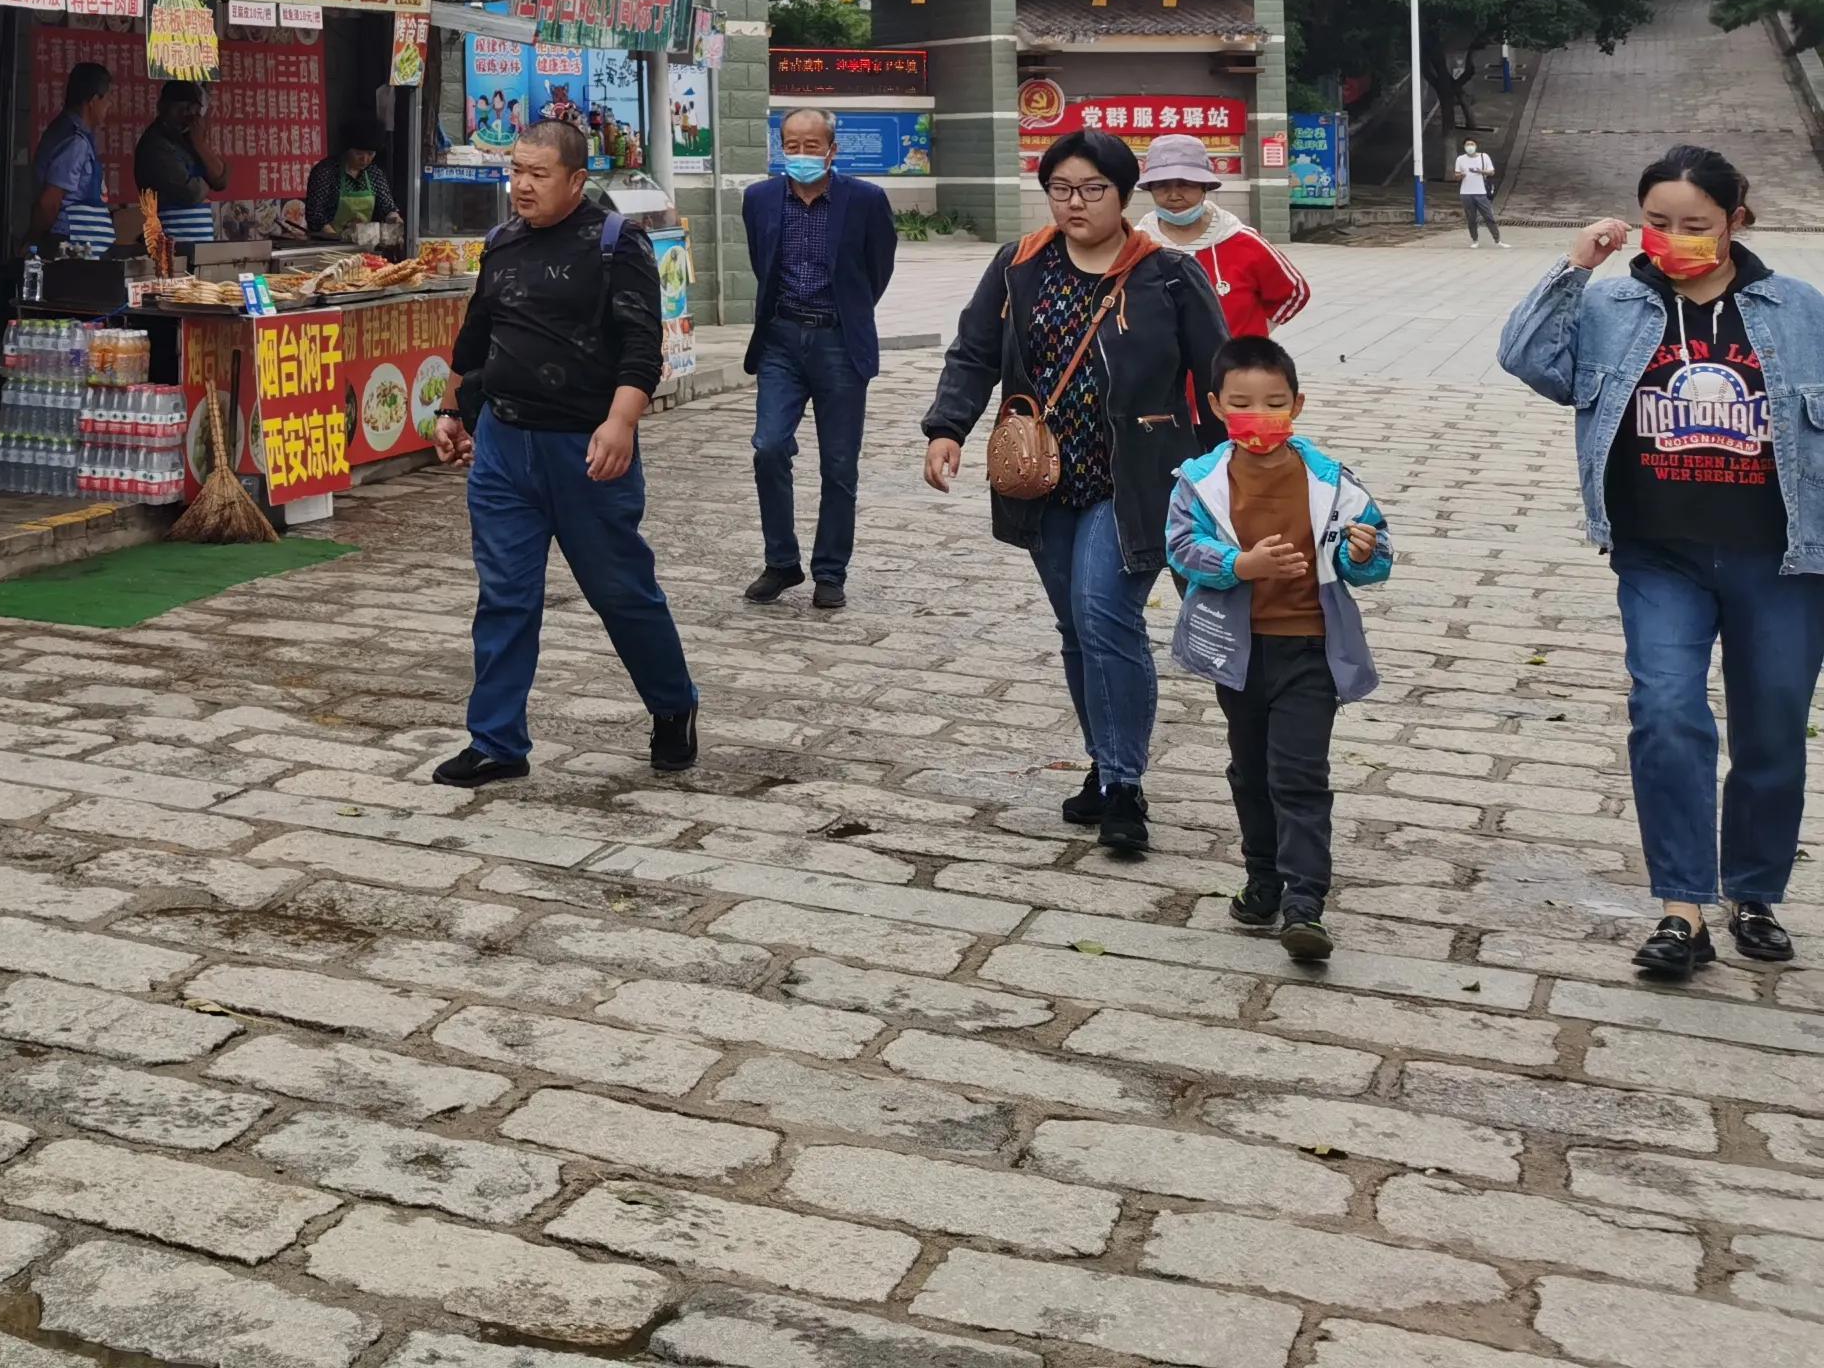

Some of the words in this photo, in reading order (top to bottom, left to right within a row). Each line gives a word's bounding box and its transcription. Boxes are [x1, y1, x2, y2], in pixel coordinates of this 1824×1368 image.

[1081, 106, 1230, 129] 党群服务驿站
[257, 322, 344, 400] 烟台焖子
[1639, 393, 1772, 441] NATIONALS
[262, 403, 351, 490] 西安凉皮
[1654, 468, 1692, 482] WER
